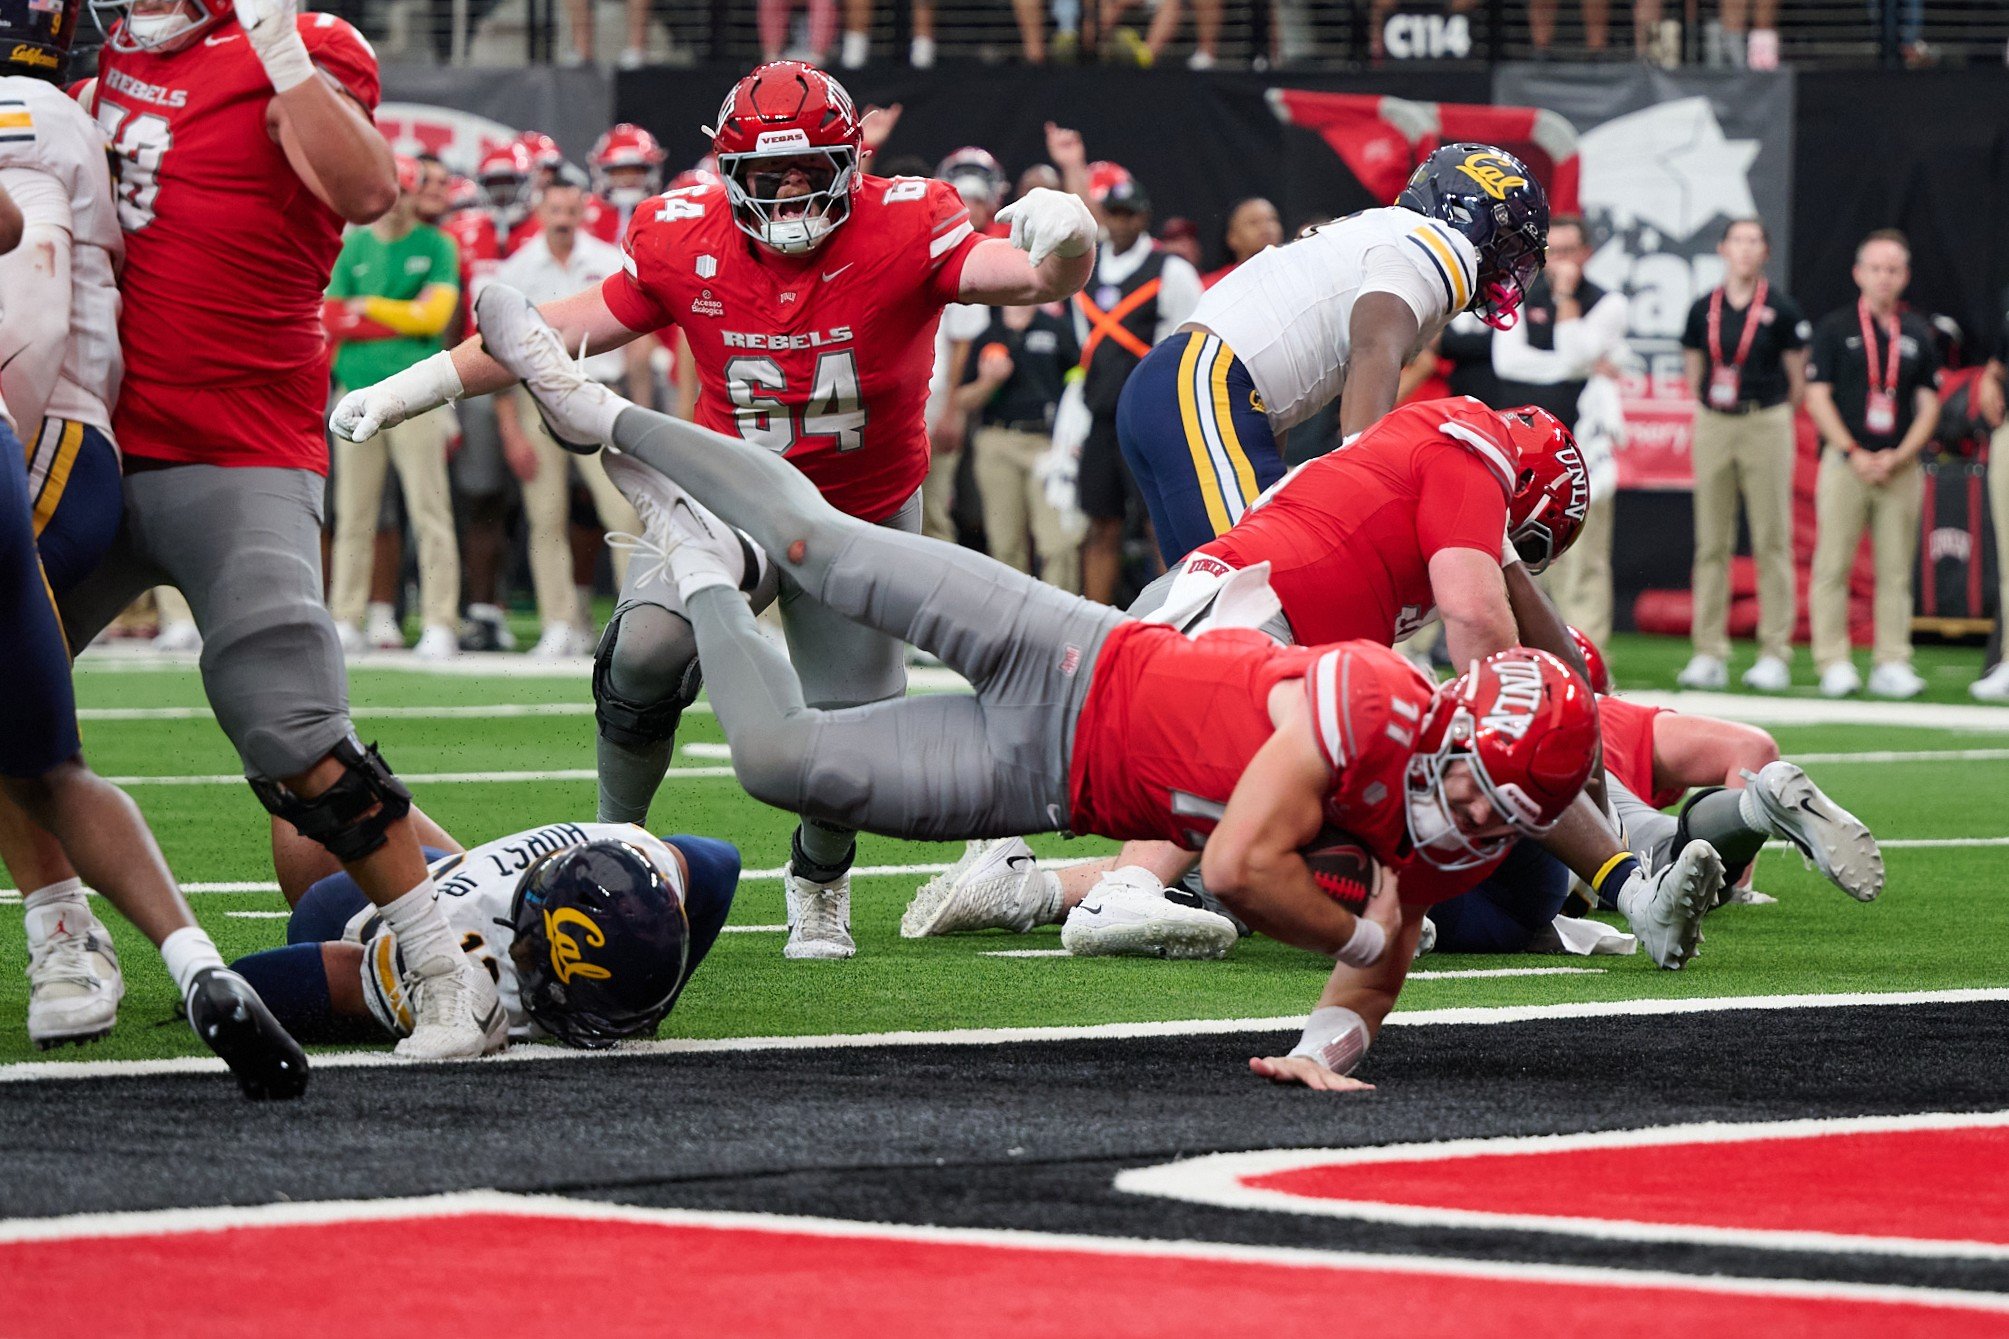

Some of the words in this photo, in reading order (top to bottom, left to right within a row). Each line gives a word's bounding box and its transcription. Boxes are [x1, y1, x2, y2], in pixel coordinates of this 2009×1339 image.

[1383, 13, 1472, 58] C114
[105, 67, 189, 108] REBELS
[1455, 153, 1527, 200] Cal
[693, 297, 723, 308] Acesso
[720, 325, 854, 350] REBELS
[723, 346, 869, 457] 64
[1555, 444, 1588, 522] UNLV
[1480, 660, 1543, 739] UNLV
[485, 821, 590, 877] HURST
[543, 906, 613, 985] Cal
